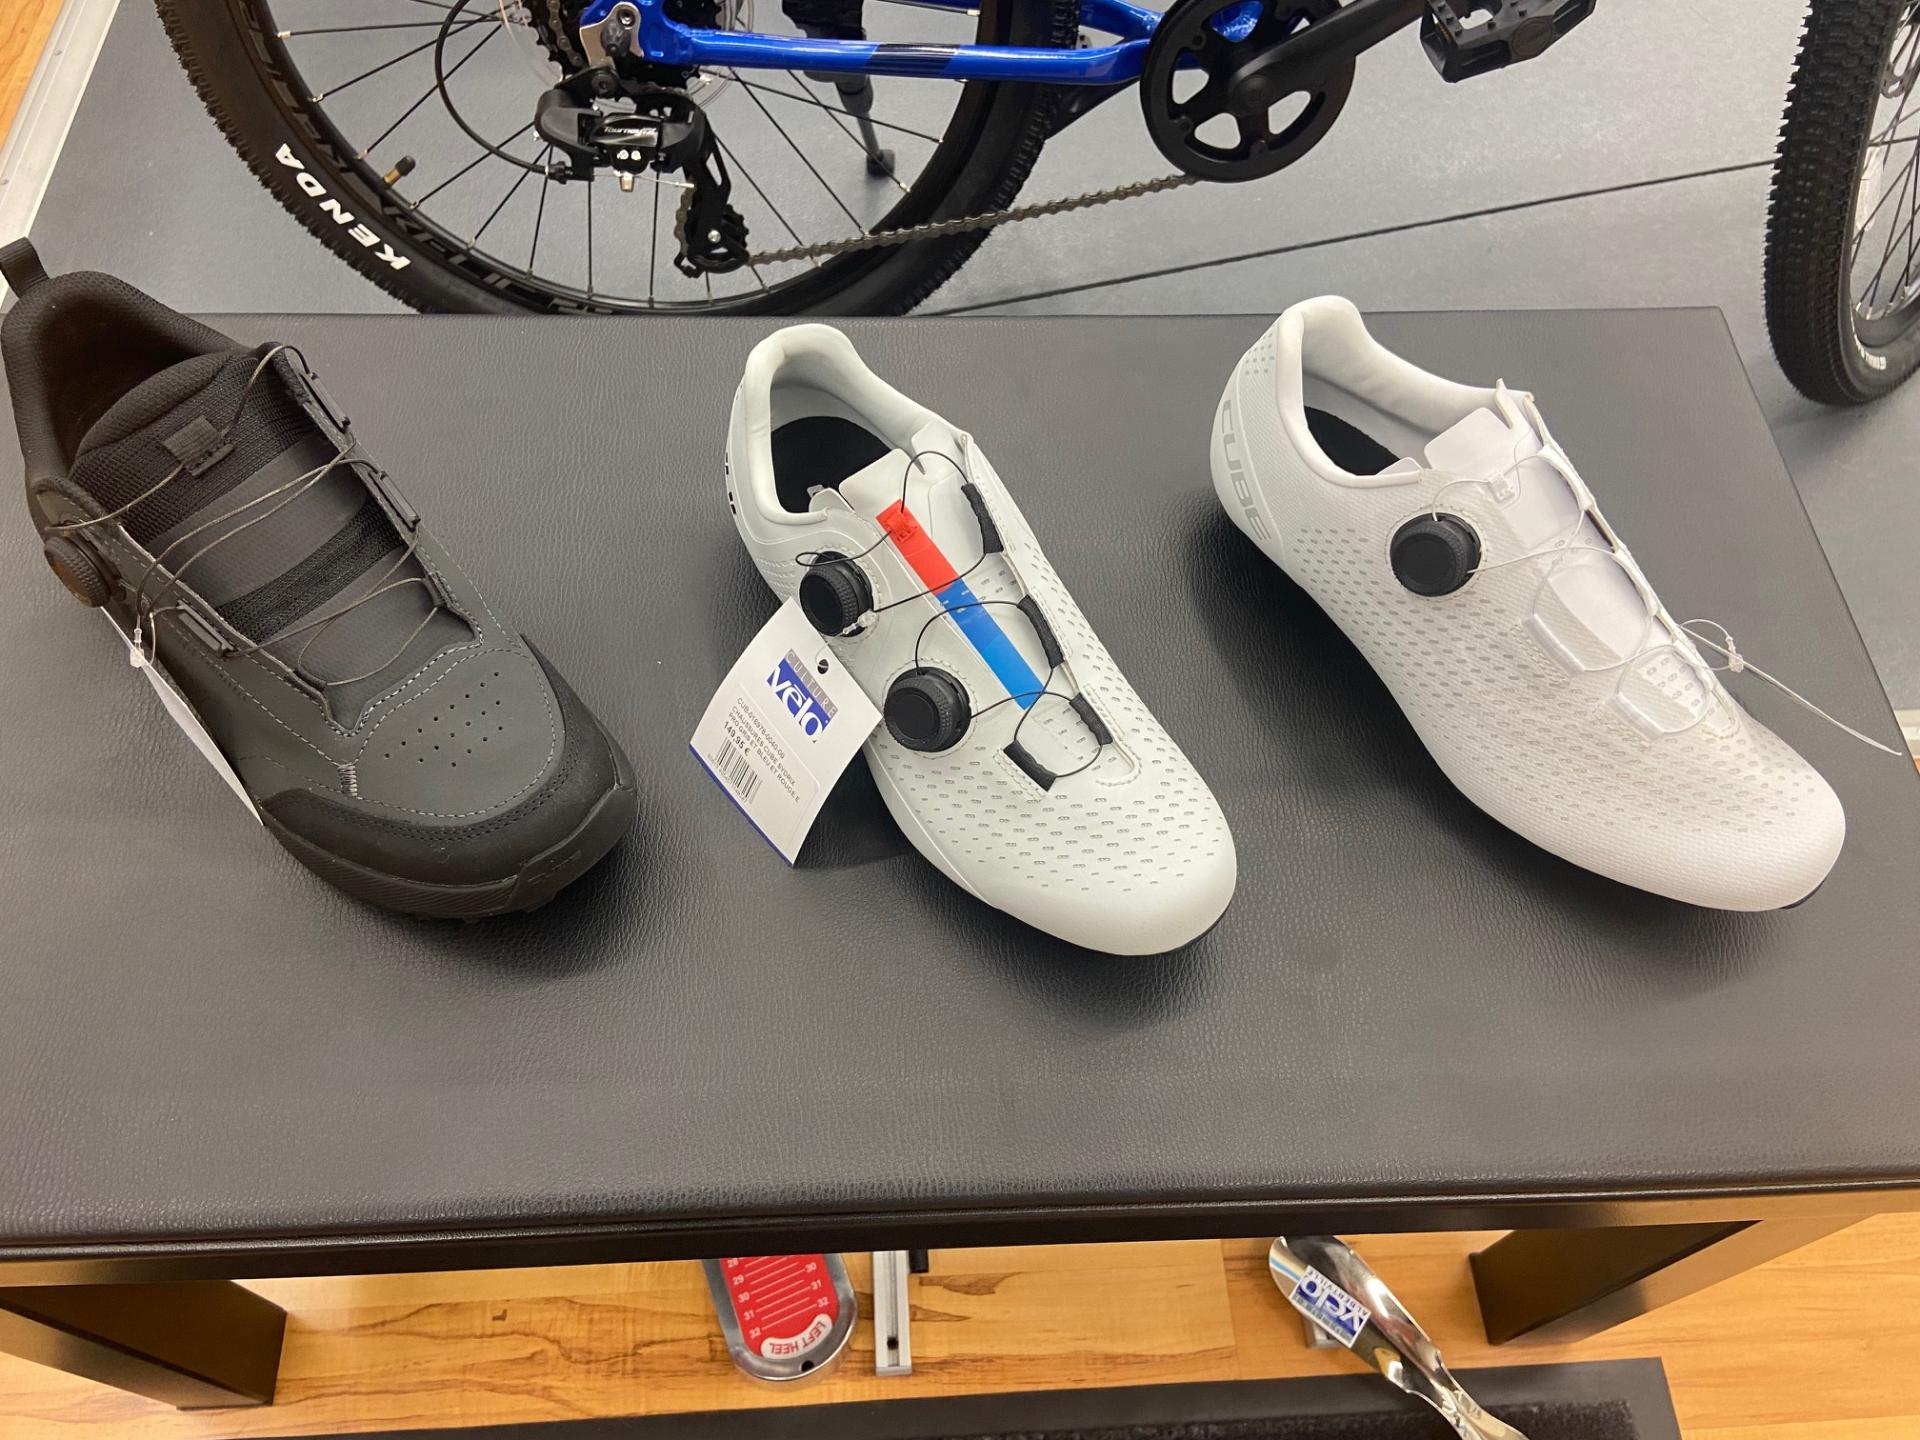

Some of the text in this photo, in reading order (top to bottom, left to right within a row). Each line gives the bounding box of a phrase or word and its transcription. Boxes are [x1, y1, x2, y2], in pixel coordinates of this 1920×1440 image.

[275, 143, 411, 270] KENDA
[1222, 399, 1271, 540] CUBE
[786, 652, 837, 718] CULTURE
[731, 706, 764, 747] CHAUSSURES
[763, 743, 778, 764] CUBE
[727, 712, 739, 727] PRO
[738, 725, 751, 741] GRIS
[750, 738, 758, 749] ET
[756, 748, 771, 766] BLEU
[769, 764, 778, 774] ET
[776, 773, 796, 798] ROUGE
[744, 747, 751, 756] €
[805, 1262, 817, 1273] 30
[732, 1274, 745, 1286] 29
[811, 1279, 822, 1290] 31
[738, 1291, 750, 1303] 30
[817, 1296, 829, 1308] 32
[743, 1310, 755, 1321] 31
[749, 1327, 761, 1338] 32
[769, 1321, 826, 1355] LEFT HEEL
